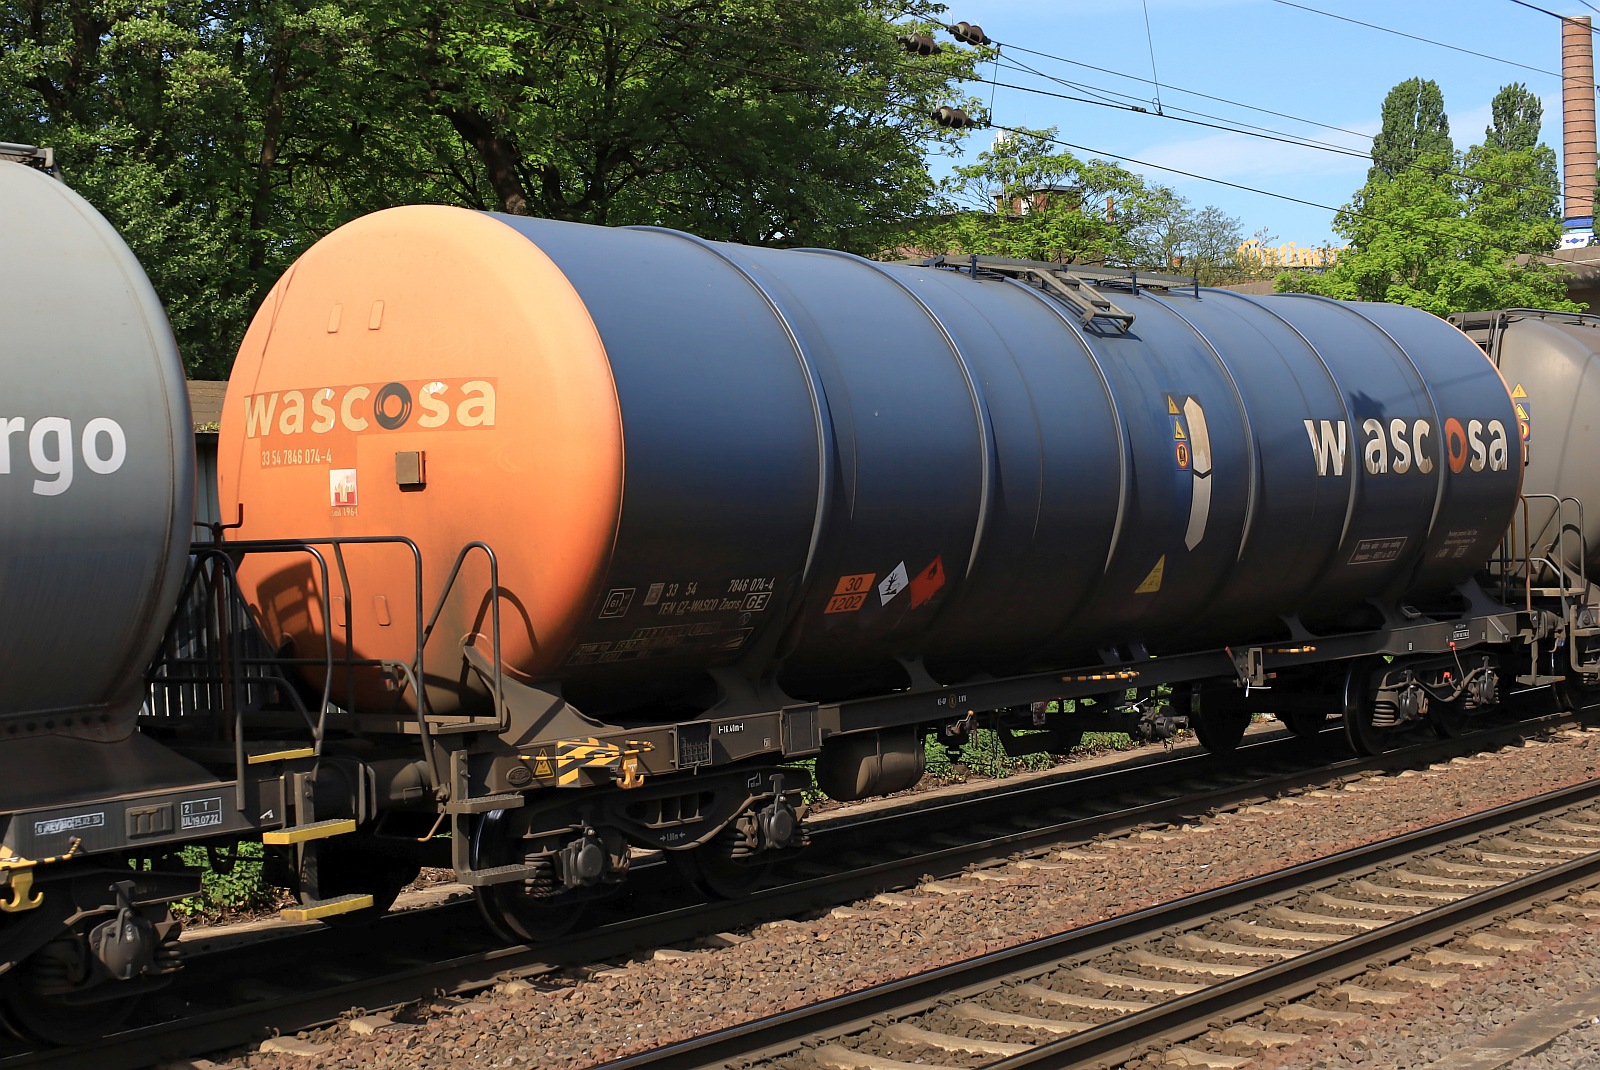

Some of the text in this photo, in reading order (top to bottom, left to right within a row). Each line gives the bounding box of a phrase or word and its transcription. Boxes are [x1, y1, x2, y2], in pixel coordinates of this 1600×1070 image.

[244, 380, 496, 438] wascosa
[1303, 418, 1508, 476] wascosa
[0, 416, 127, 496] rgo
[262, 448, 332, 466] 33 54 7846 074-4
[343, 507, 358, 516] 1964
[666, 583, 679, 597] 33
[685, 582, 698, 596] 54
[728, 578, 749, 592] 7846
[750, 577, 775, 591] 074-4
[846, 577, 863, 592] 30
[746, 594, 767, 609] GE
[830, 595, 862, 611] 1202
[184, 801, 209, 814] 2 T
